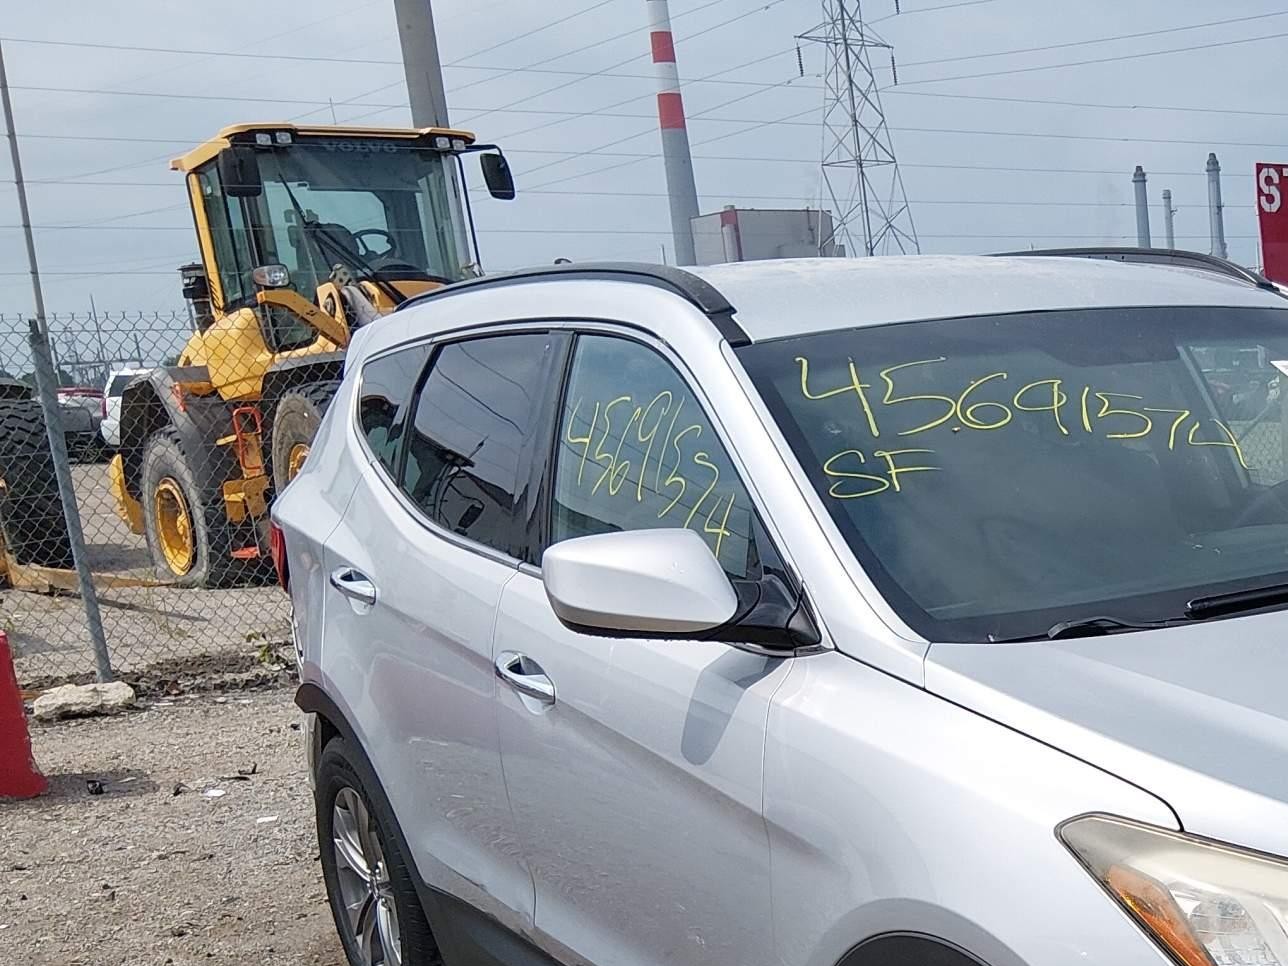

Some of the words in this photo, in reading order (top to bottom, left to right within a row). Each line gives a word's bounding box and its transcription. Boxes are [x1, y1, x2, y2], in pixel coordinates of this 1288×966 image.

[321, 141, 399, 153] VOLVO
[795, 356, 1256, 471] 45691574
[823, 447, 942, 499] SF
